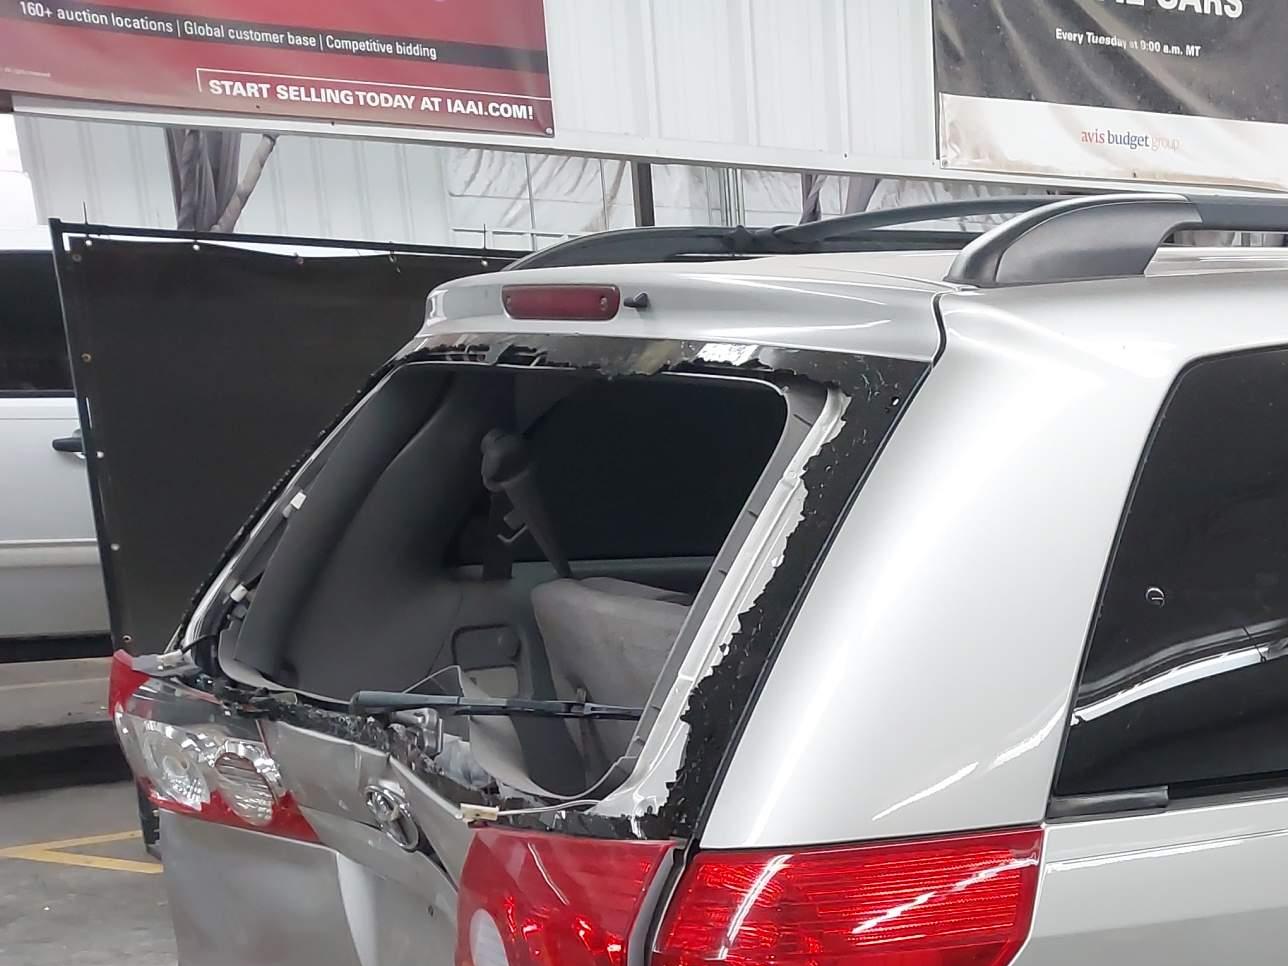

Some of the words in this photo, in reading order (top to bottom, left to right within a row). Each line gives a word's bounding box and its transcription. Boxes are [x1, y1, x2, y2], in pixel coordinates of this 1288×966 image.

[20, 1, 53, 17] 160+
[57, 8, 109, 25] auction
[112, 12, 174, 33] locations
[184, 20, 225, 38] Global
[228, 27, 285, 44] customer
[287, 31, 317, 47] base
[326, 35, 393, 55] Competitive
[395, 42, 437, 60] bidding
[1055, 27, 1083, 45] Every
[1086, 31, 1127, 49] Tuesday
[1129, 39, 1138, 50] at
[1140, 39, 1161, 52] 9:00
[1163, 44, 1183, 56] a.m.
[1185, 45, 1201, 57] MT
[208, 79, 271, 99] START
[276, 84, 354, 105] SELLING
[355, 90, 416, 110] TODAY
[420, 96, 443, 112] AT
[446, 98, 535, 120] IAAI.COM!
[1081, 128, 1105, 144] avis
[1107, 129, 1150, 150] budget
[1151, 137, 1180, 152] group
